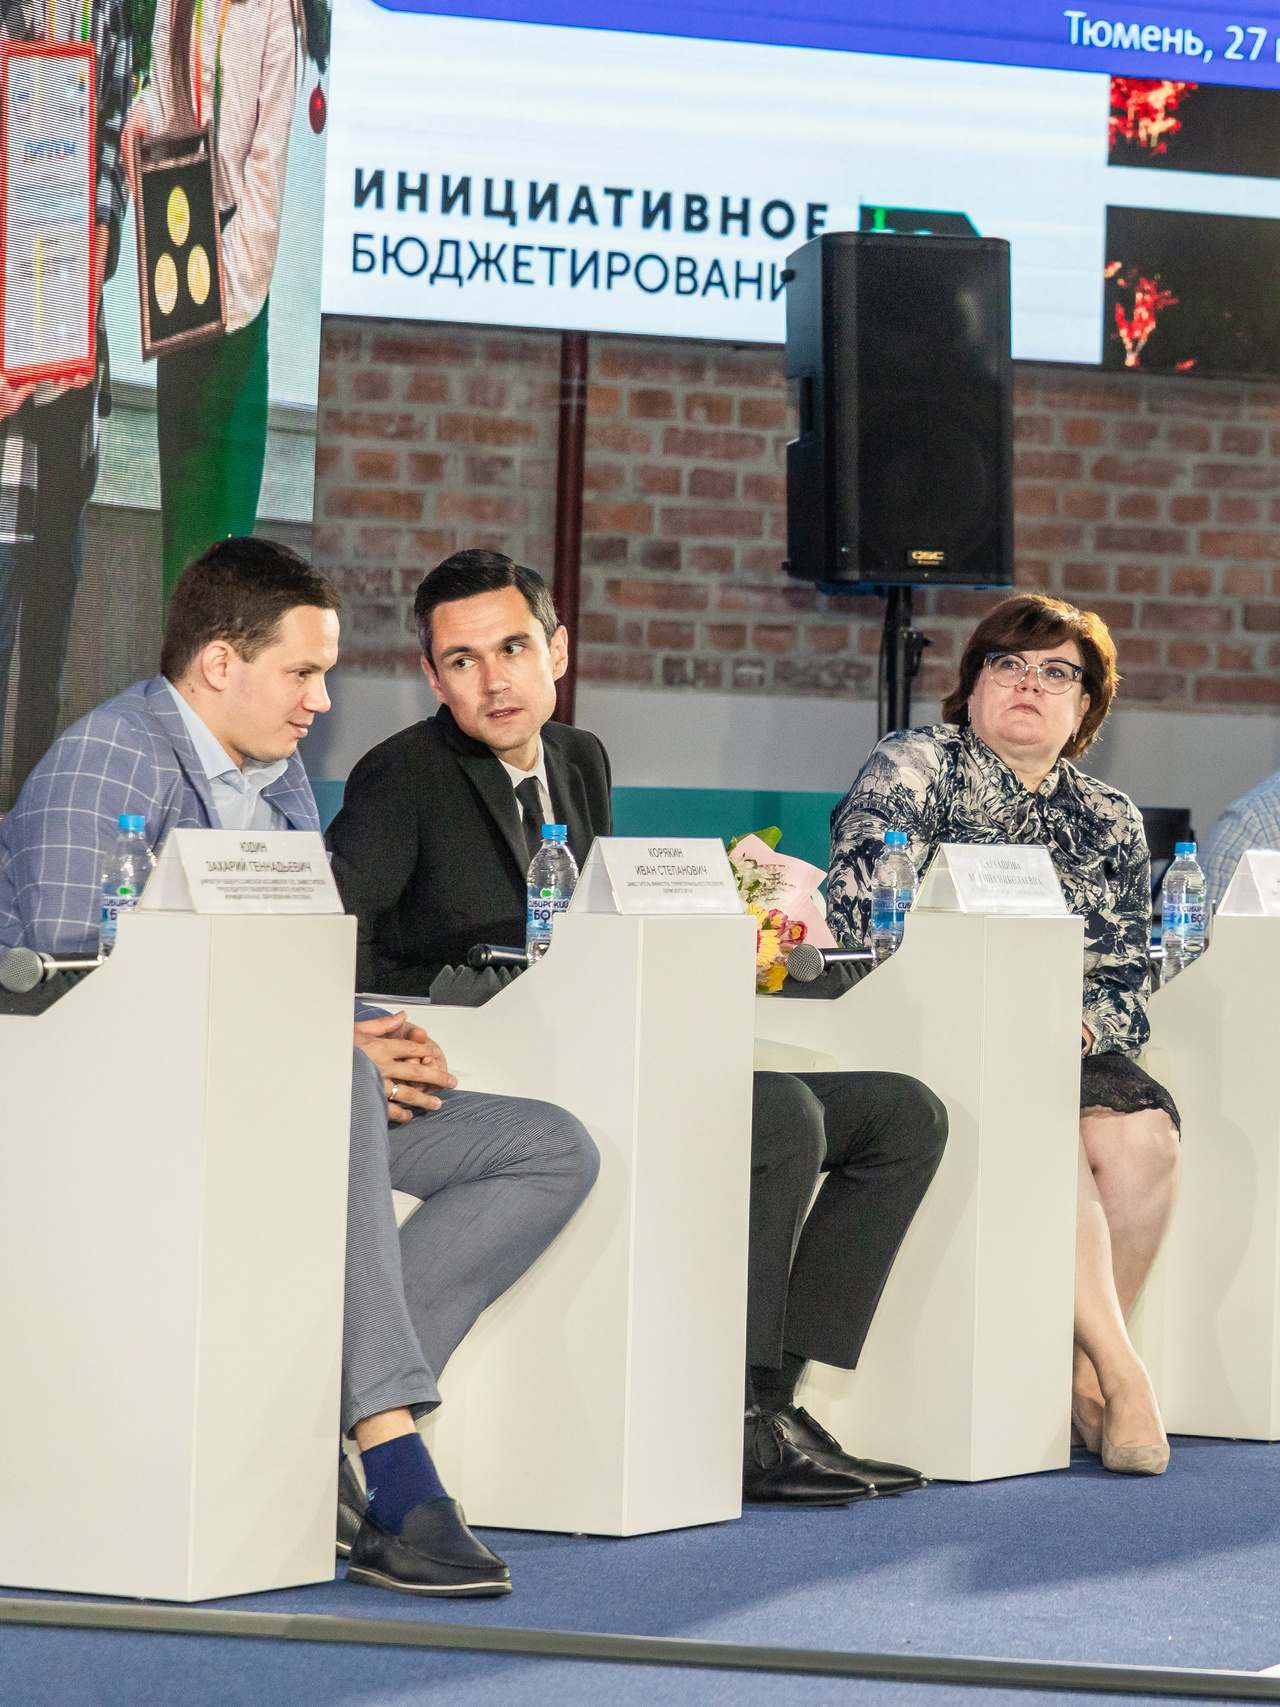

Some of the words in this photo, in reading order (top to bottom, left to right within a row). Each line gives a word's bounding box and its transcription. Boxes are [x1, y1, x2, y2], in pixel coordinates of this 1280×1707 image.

[1063, 10, 1214, 63] Тюмень,
[1223, 25, 1268, 60] 27
[353, 167, 829, 239] ИНИЦИАТИВНОЕ
[352, 233, 787, 301] БЮДЖЕТИРОВАНИ
[240, 841, 268, 853] ЮДИН
[648, 847, 685, 858] КОРЯКИН
[206, 858, 247, 872] ЗАХАРИЙ
[248, 861, 313, 874] ГЕННАДЬЕВИЧ
[634, 865, 658, 876] ИВАН
[657, 865, 708, 876] СТЕПАНОВИЧ
